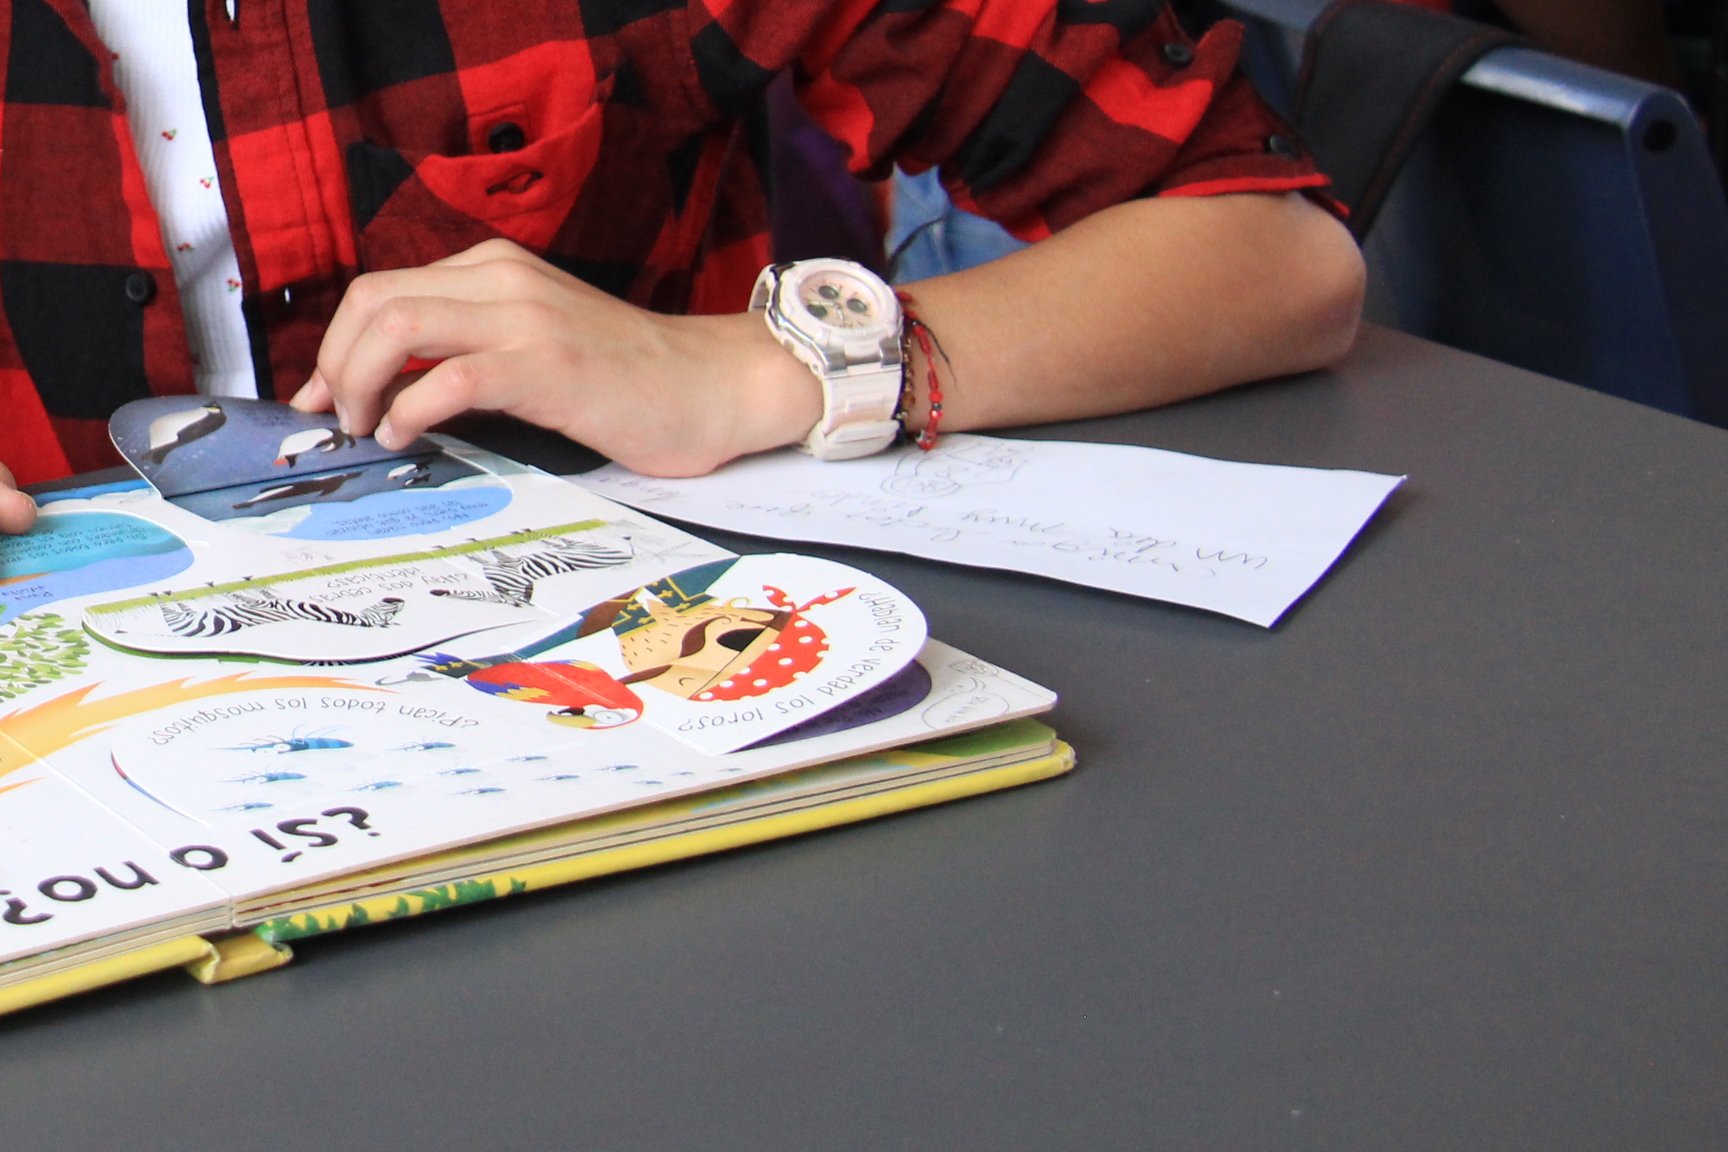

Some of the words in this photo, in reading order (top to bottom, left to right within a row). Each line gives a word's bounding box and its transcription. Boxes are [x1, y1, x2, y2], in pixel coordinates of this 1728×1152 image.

[378, 580, 414, 592] dos
[868, 636, 901, 654] de
[816, 658, 881, 697] verdad
[274, 696, 307, 711] los
[320, 696, 387, 714] todos
[774, 694, 815, 715] los
[146, 700, 266, 746] mosquitos?
[398, 704, 480, 730] ¿Pican
[677, 707, 764, 733] loros?
[249, 806, 381, 864] ¿Sí
[168, 844, 229, 871] o
